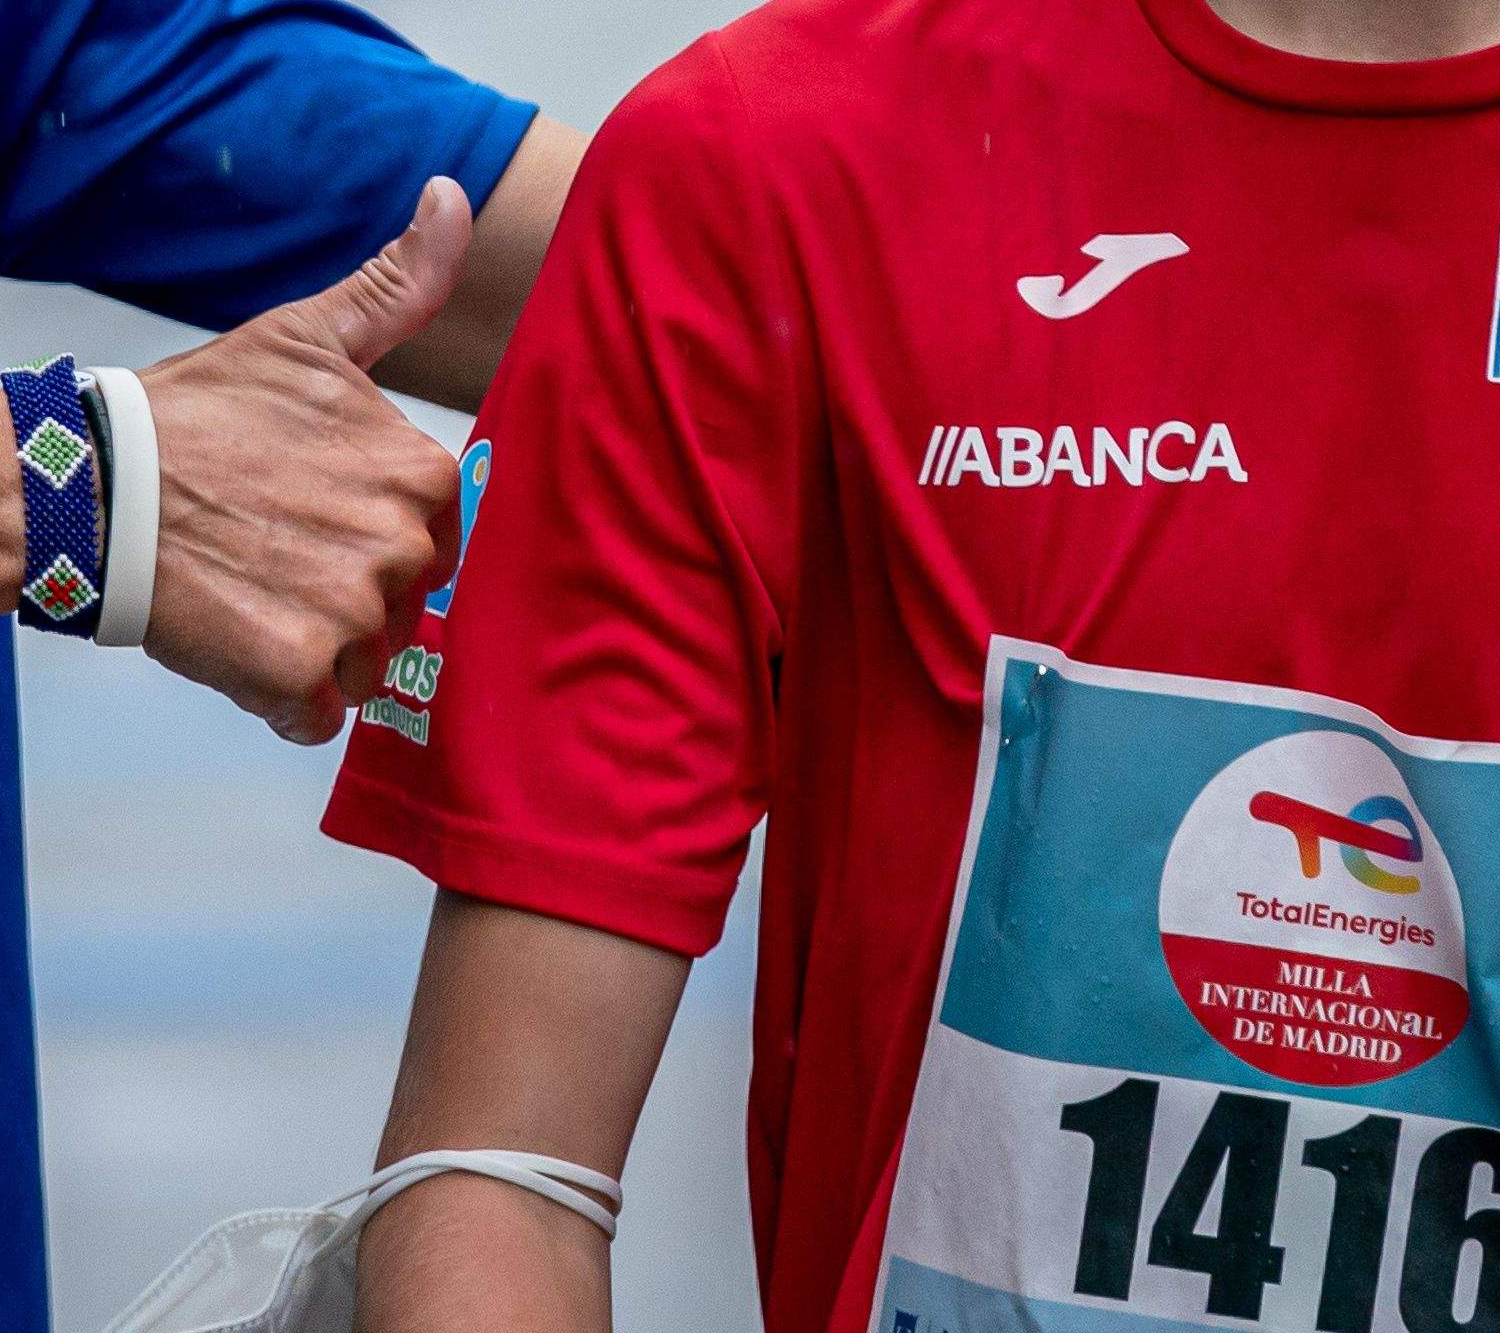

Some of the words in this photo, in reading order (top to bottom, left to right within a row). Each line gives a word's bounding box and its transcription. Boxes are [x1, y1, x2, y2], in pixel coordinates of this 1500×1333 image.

[1236, 891, 1435, 947] TotalEnergies
[1278, 961, 1373, 998] MILLA
[1233, 1017, 1274, 1045] DE
[1281, 1024, 1402, 1064] MADRID
